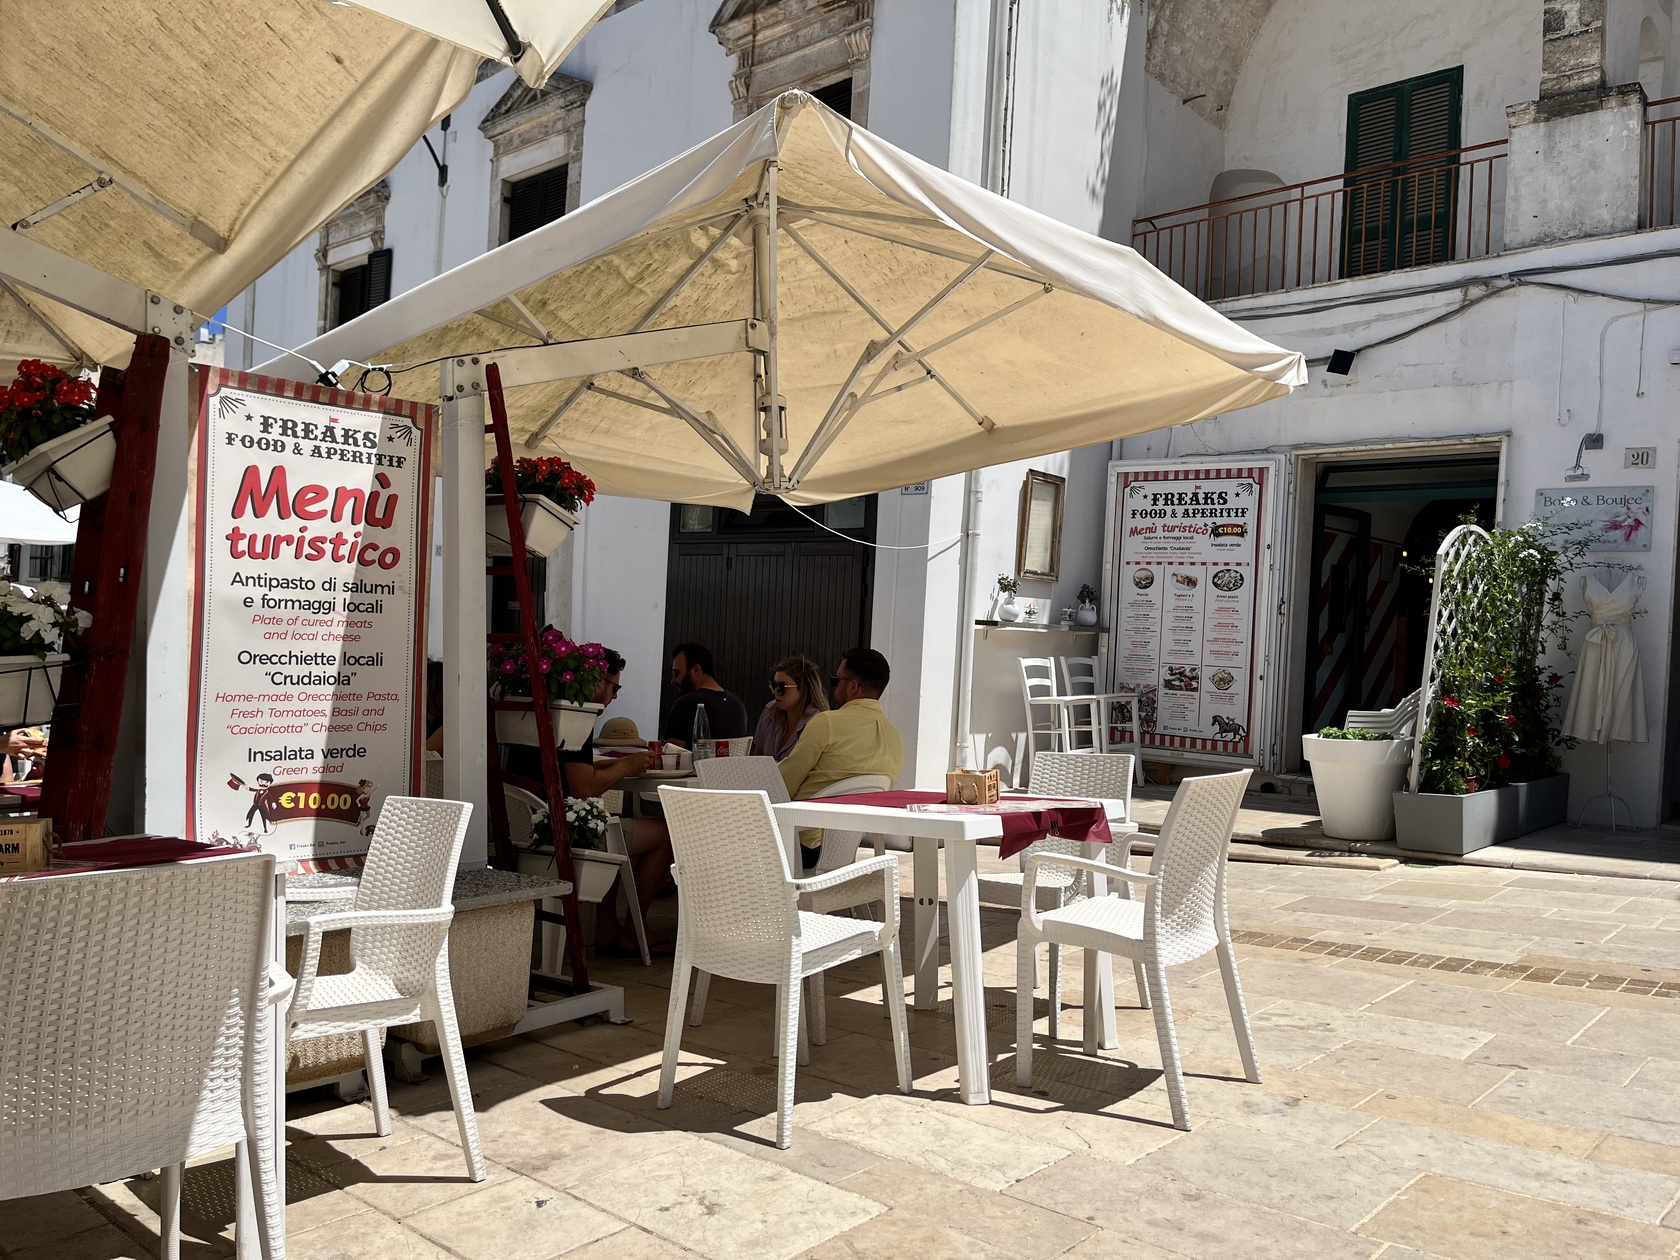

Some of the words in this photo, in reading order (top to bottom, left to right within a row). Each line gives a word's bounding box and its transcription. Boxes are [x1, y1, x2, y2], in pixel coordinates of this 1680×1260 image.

[259, 415, 378, 450] FREAKS
[225, 432, 286, 453] FOOD
[292, 441, 303, 456] &
[310, 445, 407, 468] APERITIF
[1631, 451, 1650, 466] 20
[230, 464, 399, 530] Menù
[1150, 491, 1228, 507] FREAKS
[1580, 495, 1593, 506] &
[1596, 494, 1643, 508] Boujee
[1130, 508, 1167, 520] FOOD
[1170, 508, 1178, 519] &
[1181, 507, 1249, 519] APERITIF
[1128, 522, 1157, 538] Menù
[1161, 522, 1209, 536] turistico
[225, 525, 401, 570] turistico
[230, 571, 316, 592] Antipasto
[321, 576, 337, 592] di
[342, 578, 396, 596] salumi
[242, 597, 255, 608] e
[260, 594, 337, 615] formaggi
[342, 598, 384, 614] locali
[251, 614, 284, 626] Plate
[286, 615, 300, 628] of
[301, 615, 334, 628] cured
[336, 618, 373, 630] meats
[263, 630, 288, 641] and
[291, 630, 319, 642] local
[321, 631, 362, 643] cheese
[237, 650, 337, 666] Orecchiette
[342, 651, 384, 667] locali
[214, 691, 294, 703] Home-made
[297, 691, 364, 702] Orecchiette
[366, 691, 400, 703] Pasta,
[230, 708, 264, 719] Fresh
[268, 707, 328, 719] Tomatoes,
[331, 707, 359, 717] Basil
[361, 706, 385, 717] and
[311, 722, 353, 733] Cheese
[356, 721, 388, 734] Chips
[247, 746, 315, 763] Insalata
[321, 744, 367, 760] verde
[272, 764, 309, 776] Green
[311, 763, 345, 775] salad
[278, 792, 352, 810] €10.00
